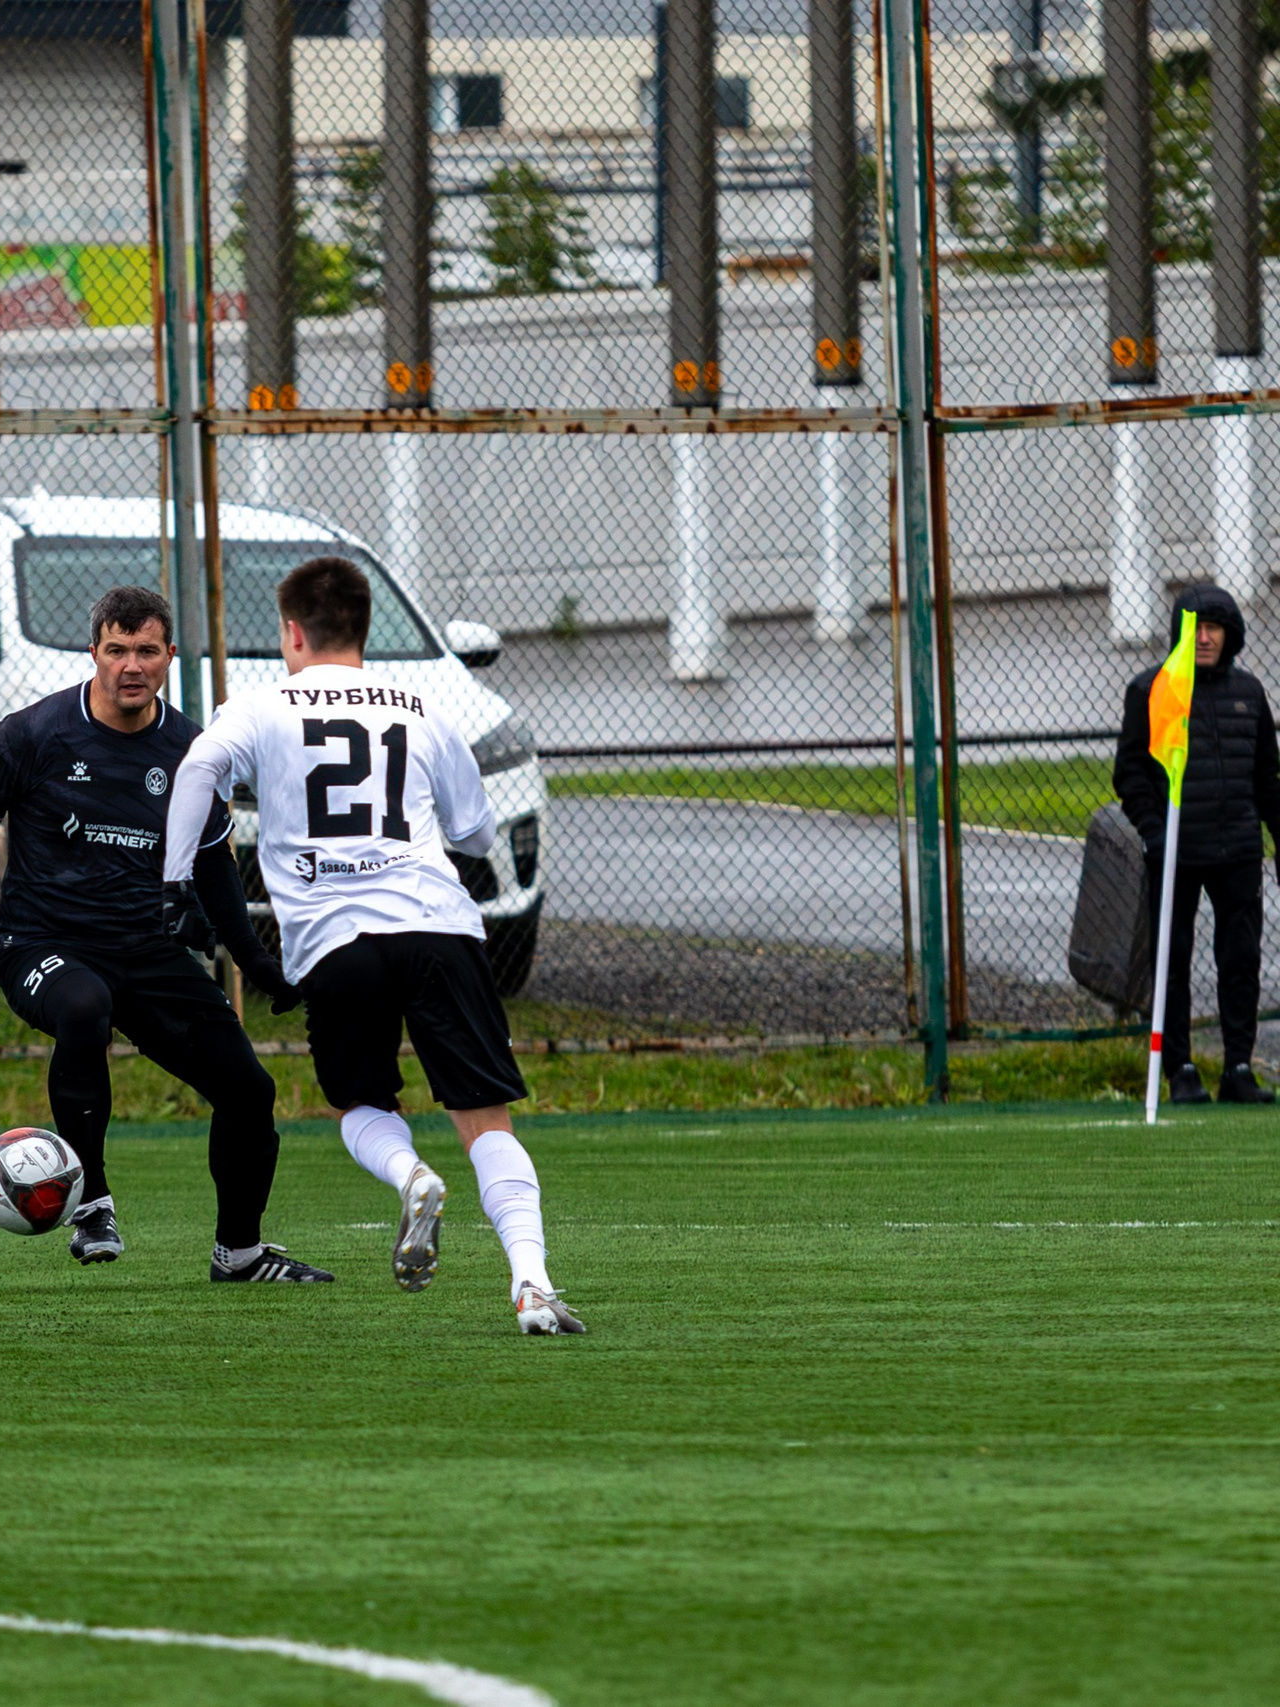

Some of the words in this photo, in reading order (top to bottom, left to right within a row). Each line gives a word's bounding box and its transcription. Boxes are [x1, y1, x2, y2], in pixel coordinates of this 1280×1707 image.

[280, 687, 425, 718] ТУРБИНА
[301, 718, 411, 843] 21
[84, 831, 158, 850] TATNEFT
[318, 861, 356, 874] Завод
[23, 954, 65, 996] 35
